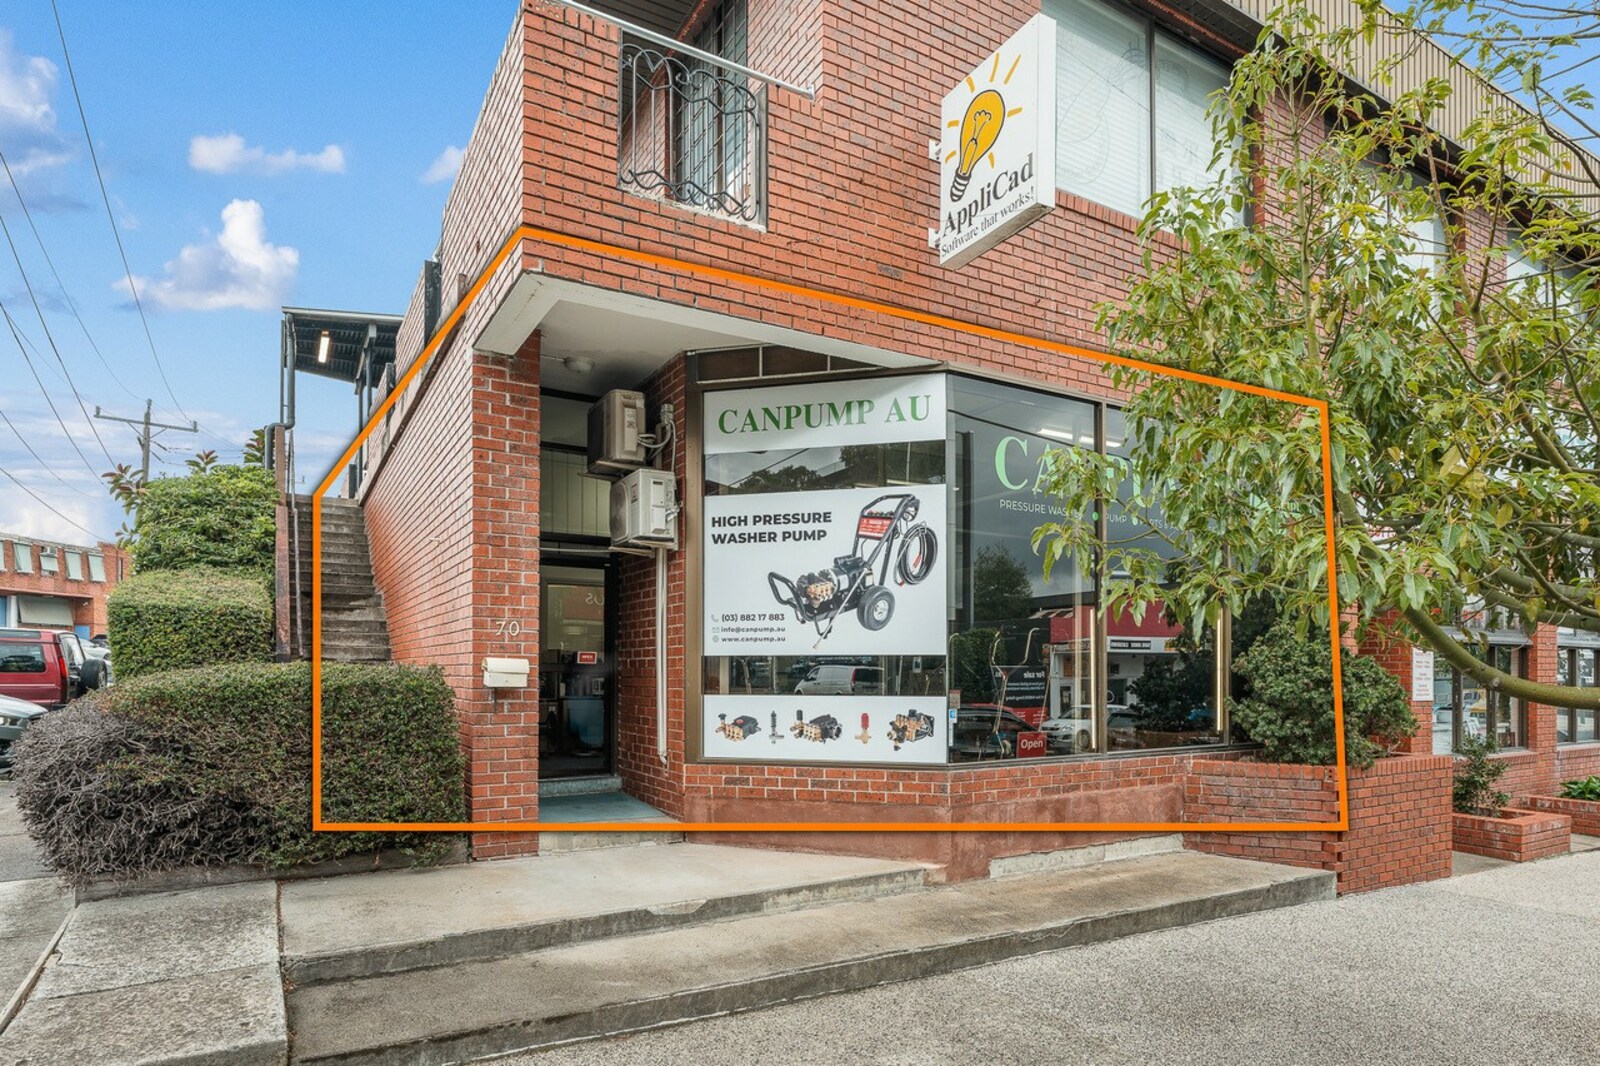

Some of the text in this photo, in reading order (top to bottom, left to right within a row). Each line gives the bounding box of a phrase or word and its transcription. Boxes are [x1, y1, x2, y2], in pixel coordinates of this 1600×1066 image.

[942, 152, 1034, 238] AppliCad
[941, 186, 1035, 257] Software that works!
[718, 394, 932, 434] CANPUMP AU
[711, 511, 832, 528] HIGH PRESSURE
[999, 499, 1046, 514] PRESSURE
[1105, 513, 1127, 524] PUMP
[711, 529, 827, 545] WASHER PUMP
[721, 613, 738, 622] (03)
[740, 614, 756, 622] 882
[768, 613, 785, 621] 883
[495, 621, 520, 637] 70
[1020, 738, 1044, 751] Open
